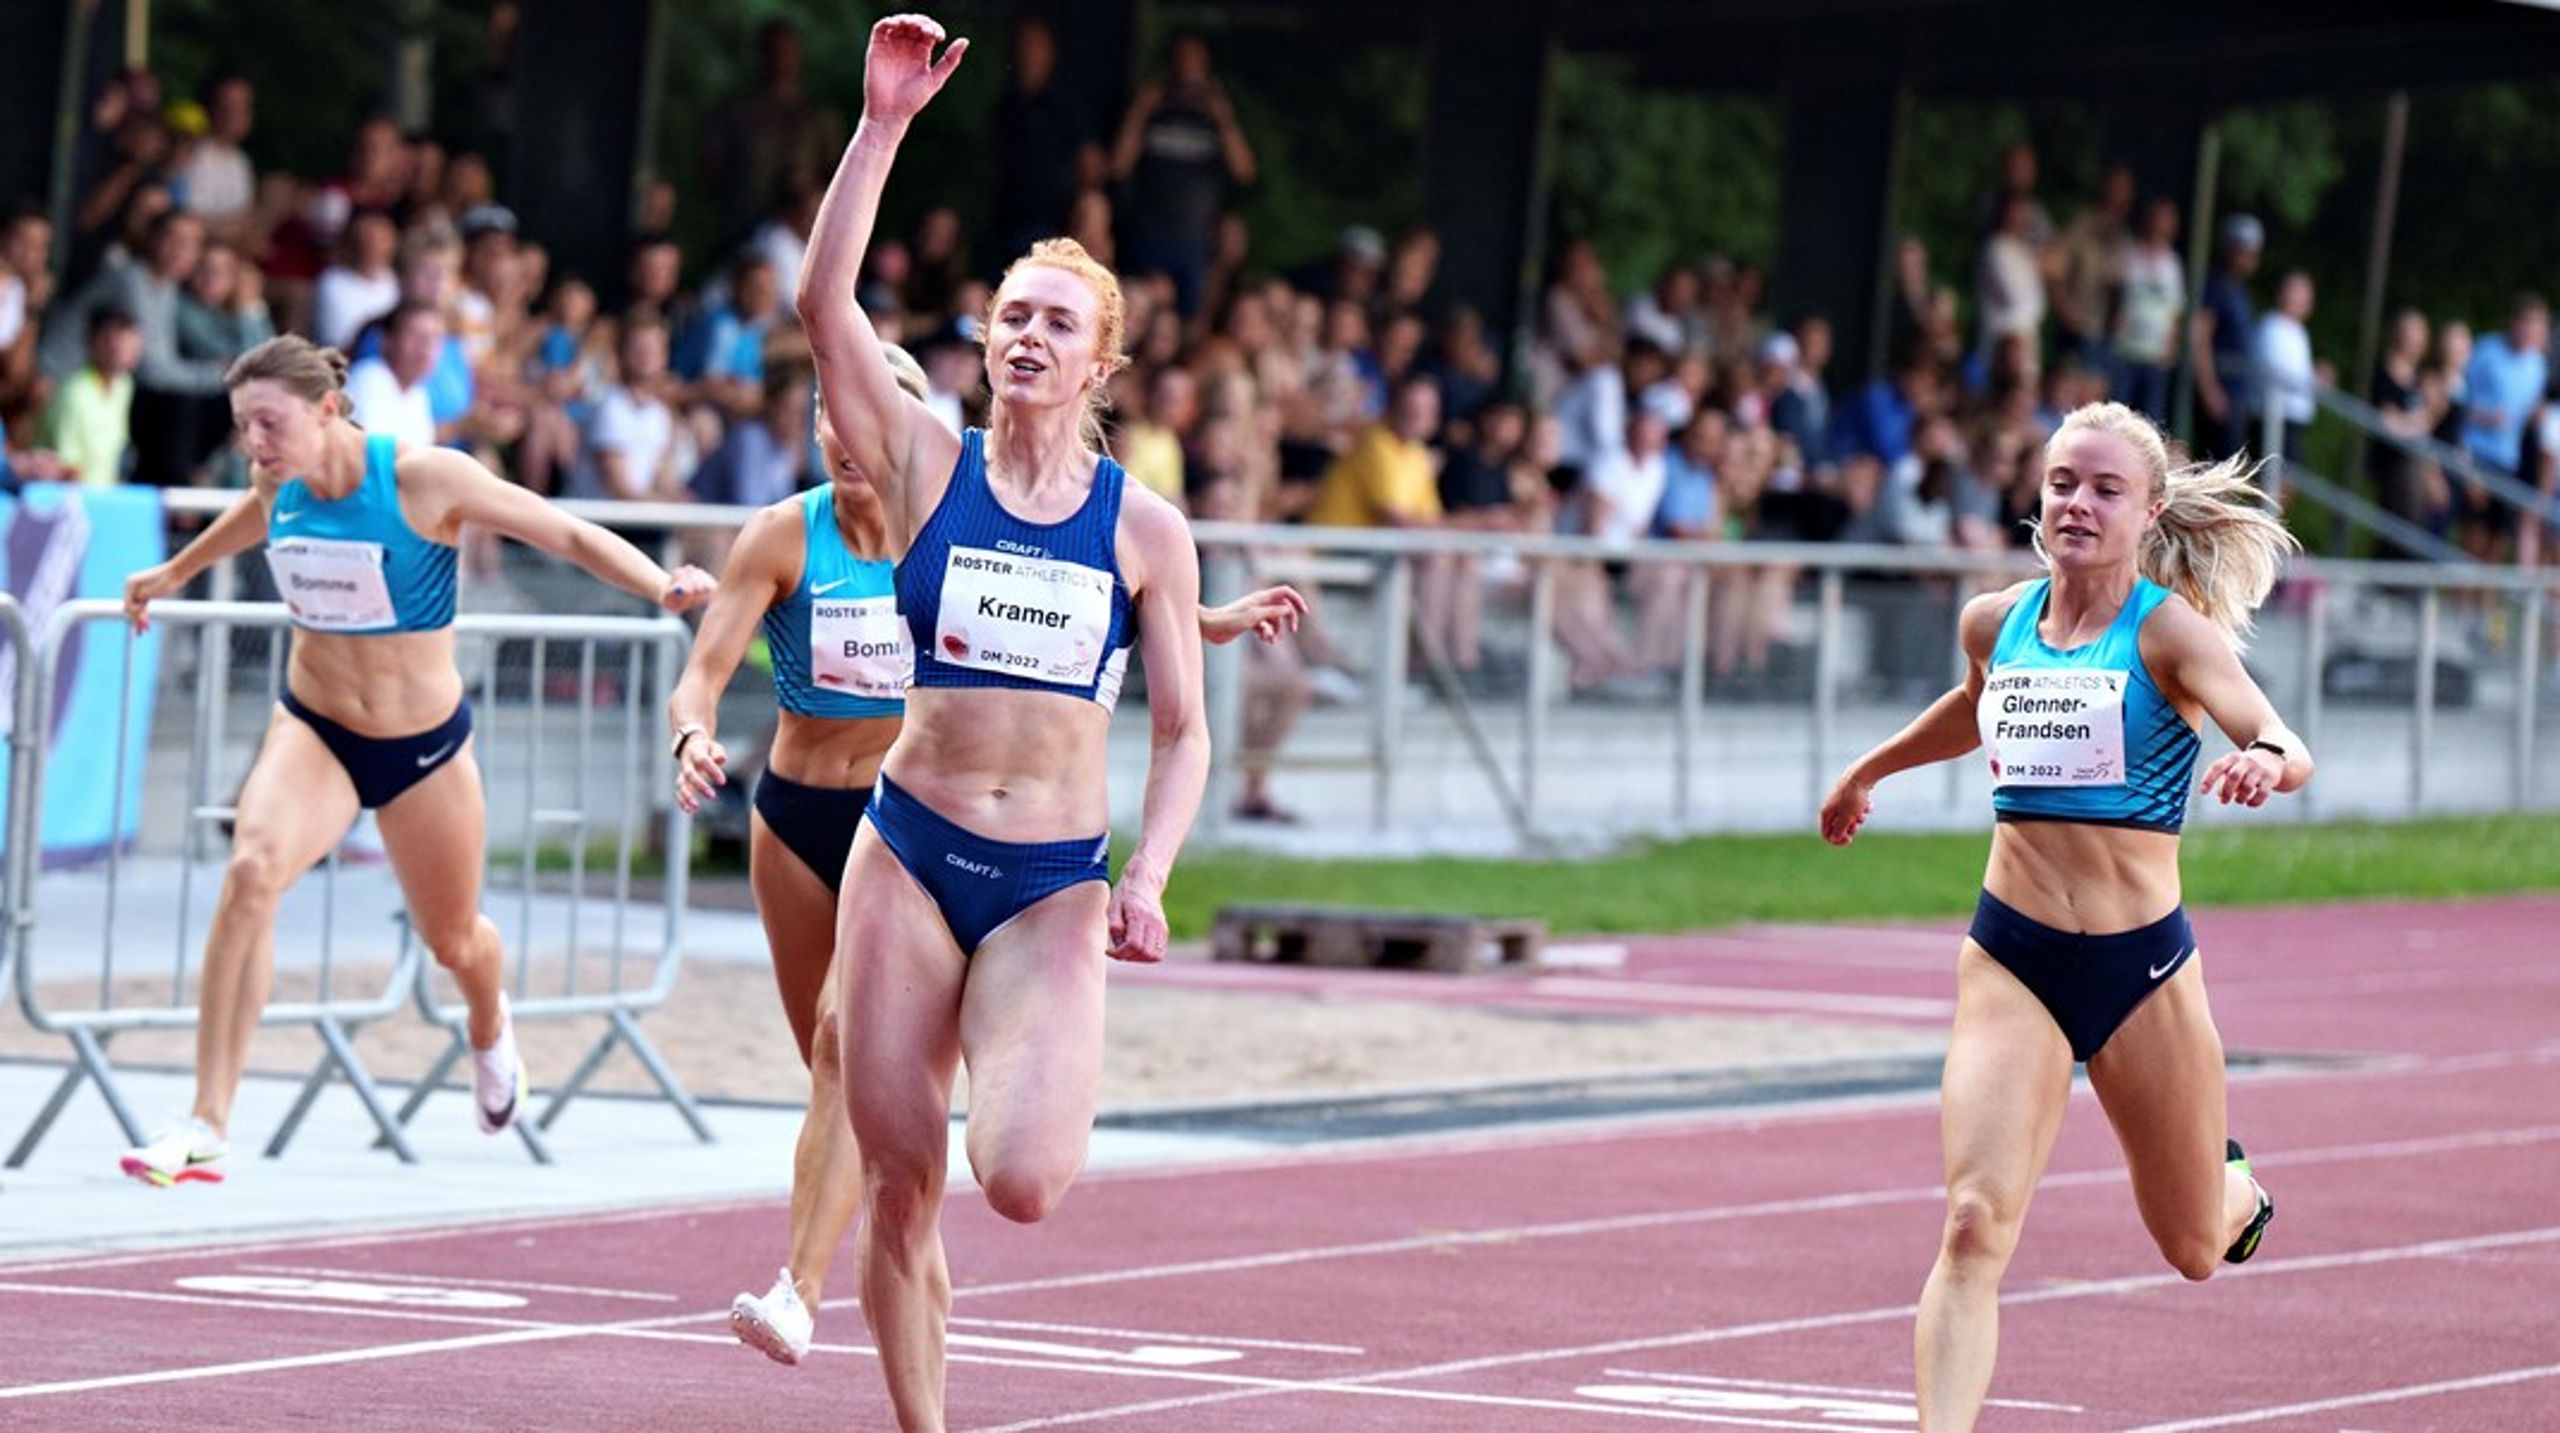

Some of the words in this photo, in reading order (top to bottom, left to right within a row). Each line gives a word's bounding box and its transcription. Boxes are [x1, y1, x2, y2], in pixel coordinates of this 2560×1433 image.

[996, 540, 1042, 556] CRAFT
[952, 555, 1013, 575] ROSTER
[1015, 565, 1088, 588] ATHLETICS
[291, 572, 358, 592] Bomme
[816, 607, 867, 618] ROSTER
[978, 595, 1071, 630] Kramer
[981, 650, 1001, 662] DM
[1006, 652, 1040, 669] 2022
[2034, 676, 2101, 690] ATHLETICS
[2003, 695, 2087, 714] Glenner-
[1996, 721, 2090, 740] Frandsen
[2006, 765, 2025, 776] DM
[2029, 765, 2063, 776] 2022
[946, 853, 991, 876] CRAFT
